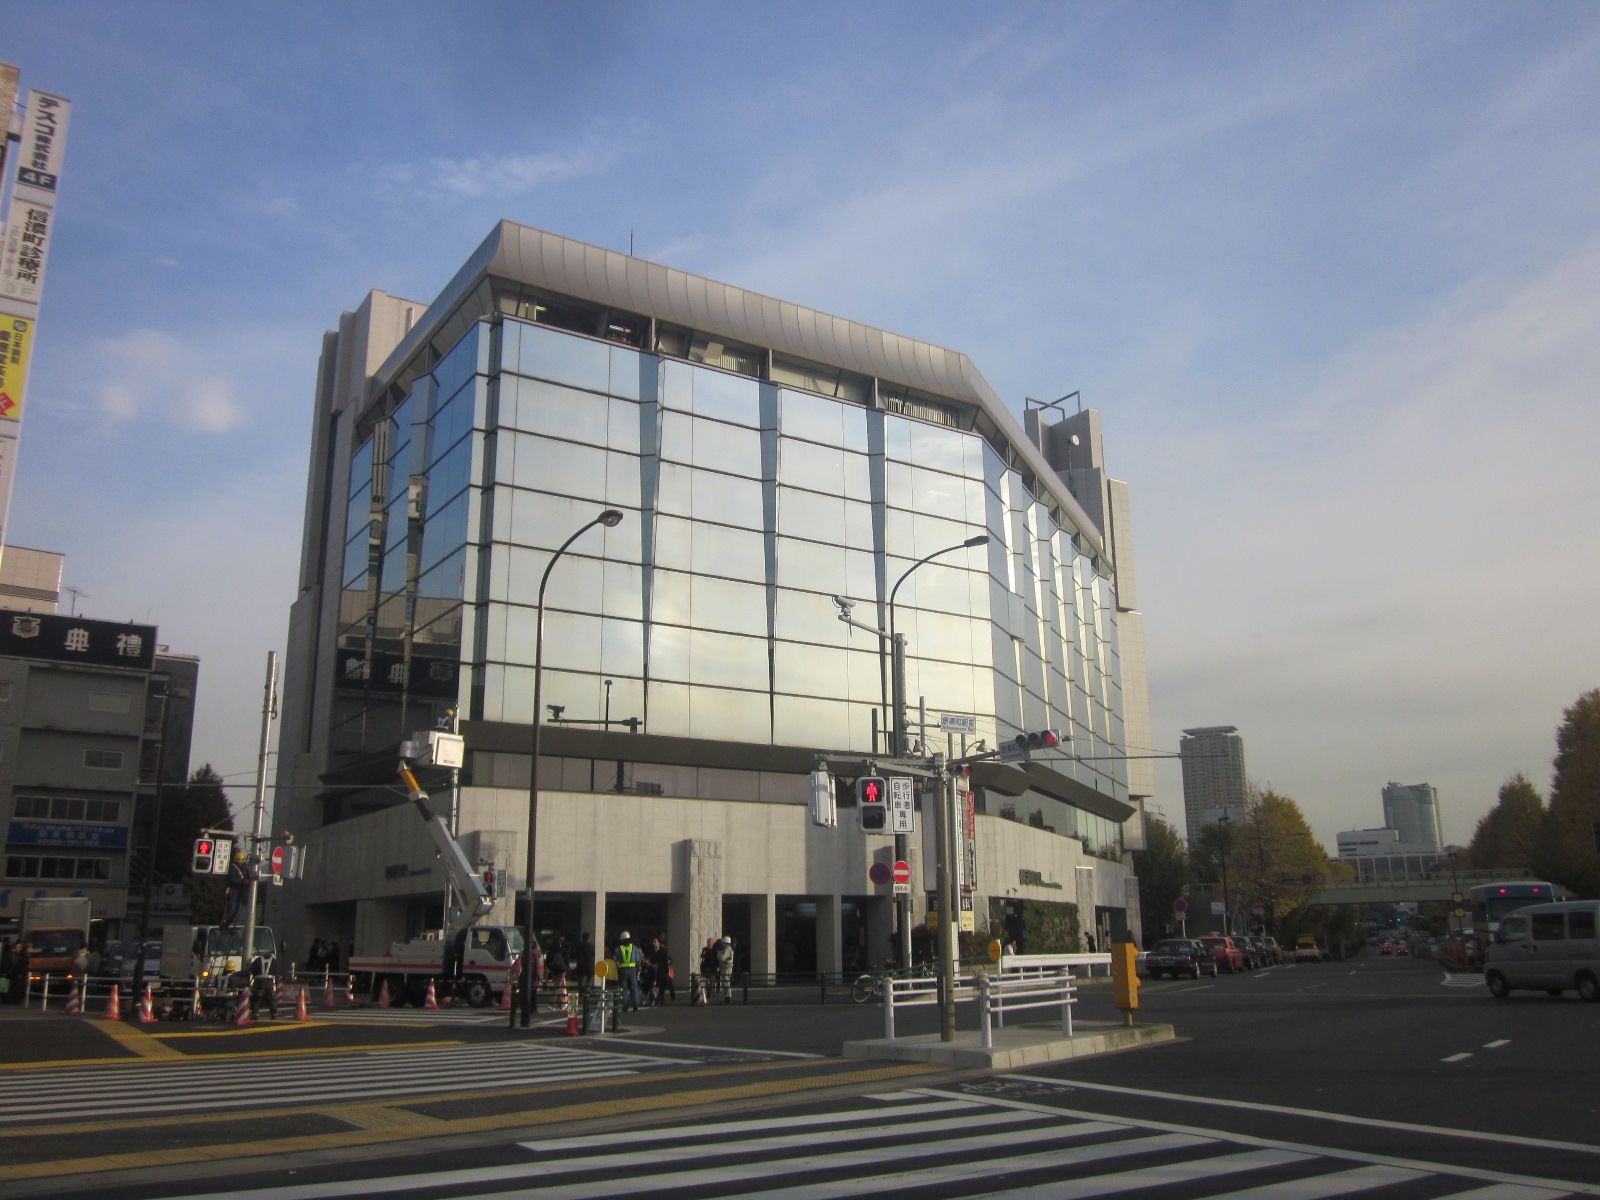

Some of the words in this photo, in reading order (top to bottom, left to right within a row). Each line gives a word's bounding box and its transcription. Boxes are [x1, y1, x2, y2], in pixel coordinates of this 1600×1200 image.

[23, 172, 52, 185] 4F
[16, 208, 49, 284] 信濃町診療所
